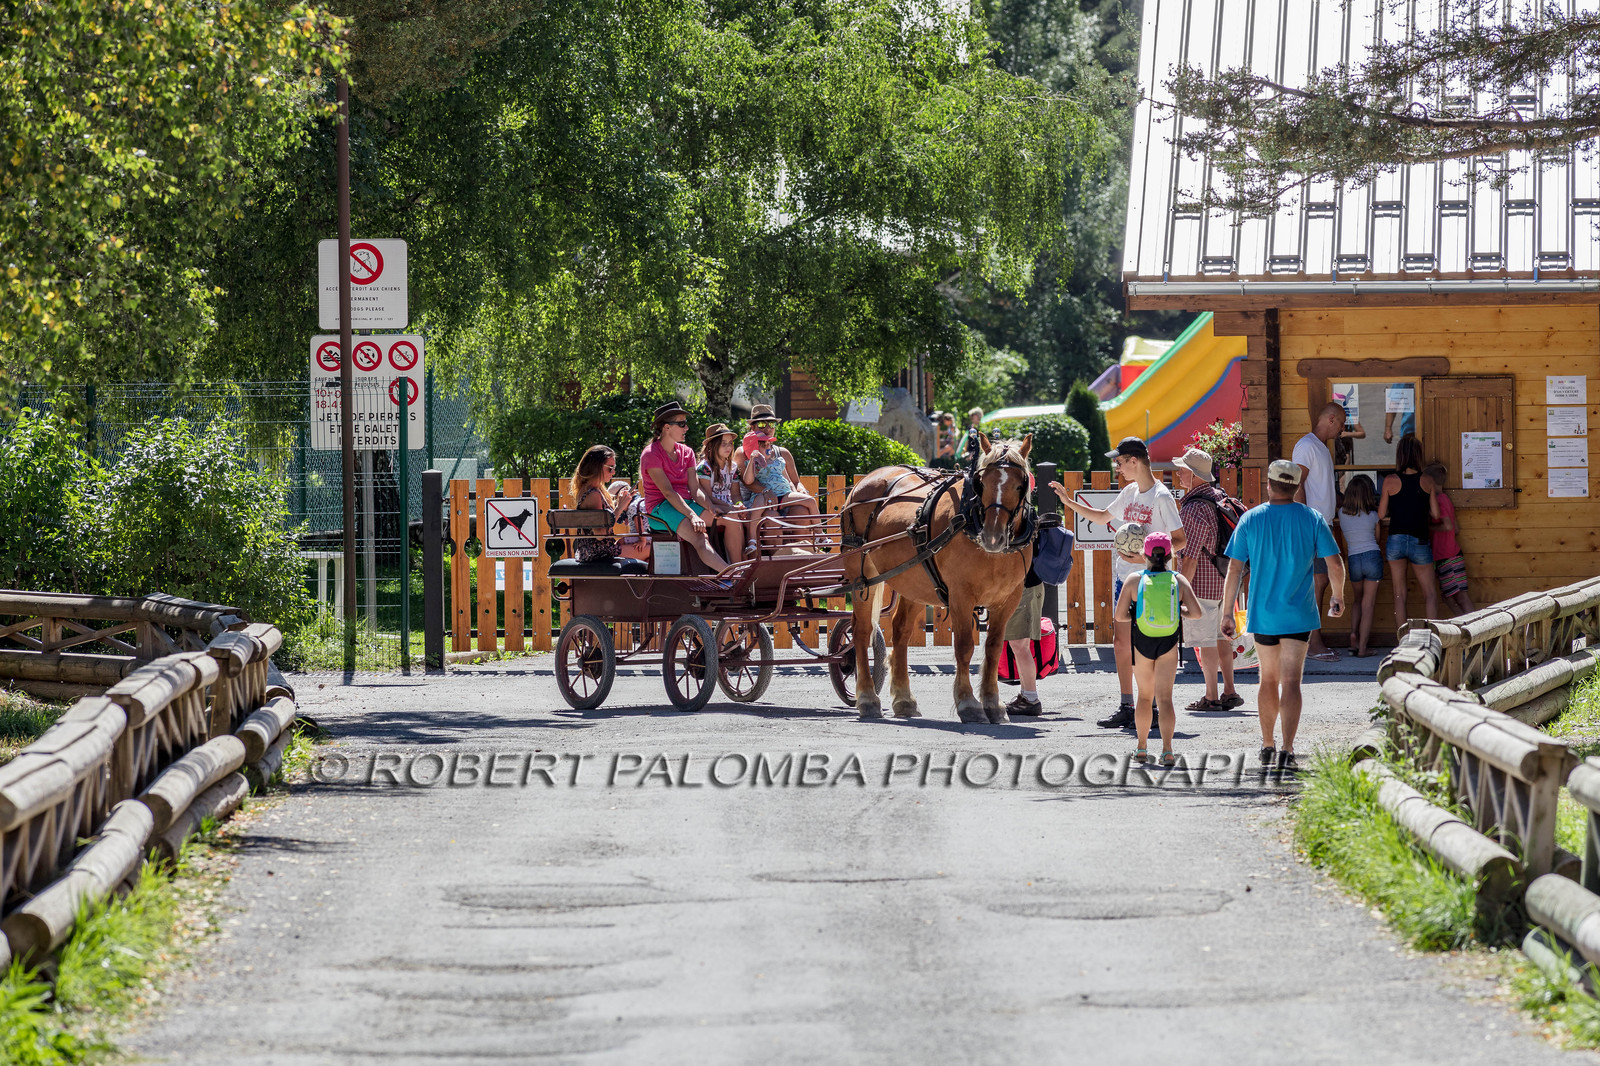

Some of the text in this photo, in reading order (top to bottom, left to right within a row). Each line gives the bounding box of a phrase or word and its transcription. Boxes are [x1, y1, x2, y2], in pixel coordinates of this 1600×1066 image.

[319, 412, 342, 422] JET
[368, 412, 417, 421] PIERRS
[364, 424, 400, 433] GALET
[339, 436, 397, 445] ITERDITS
